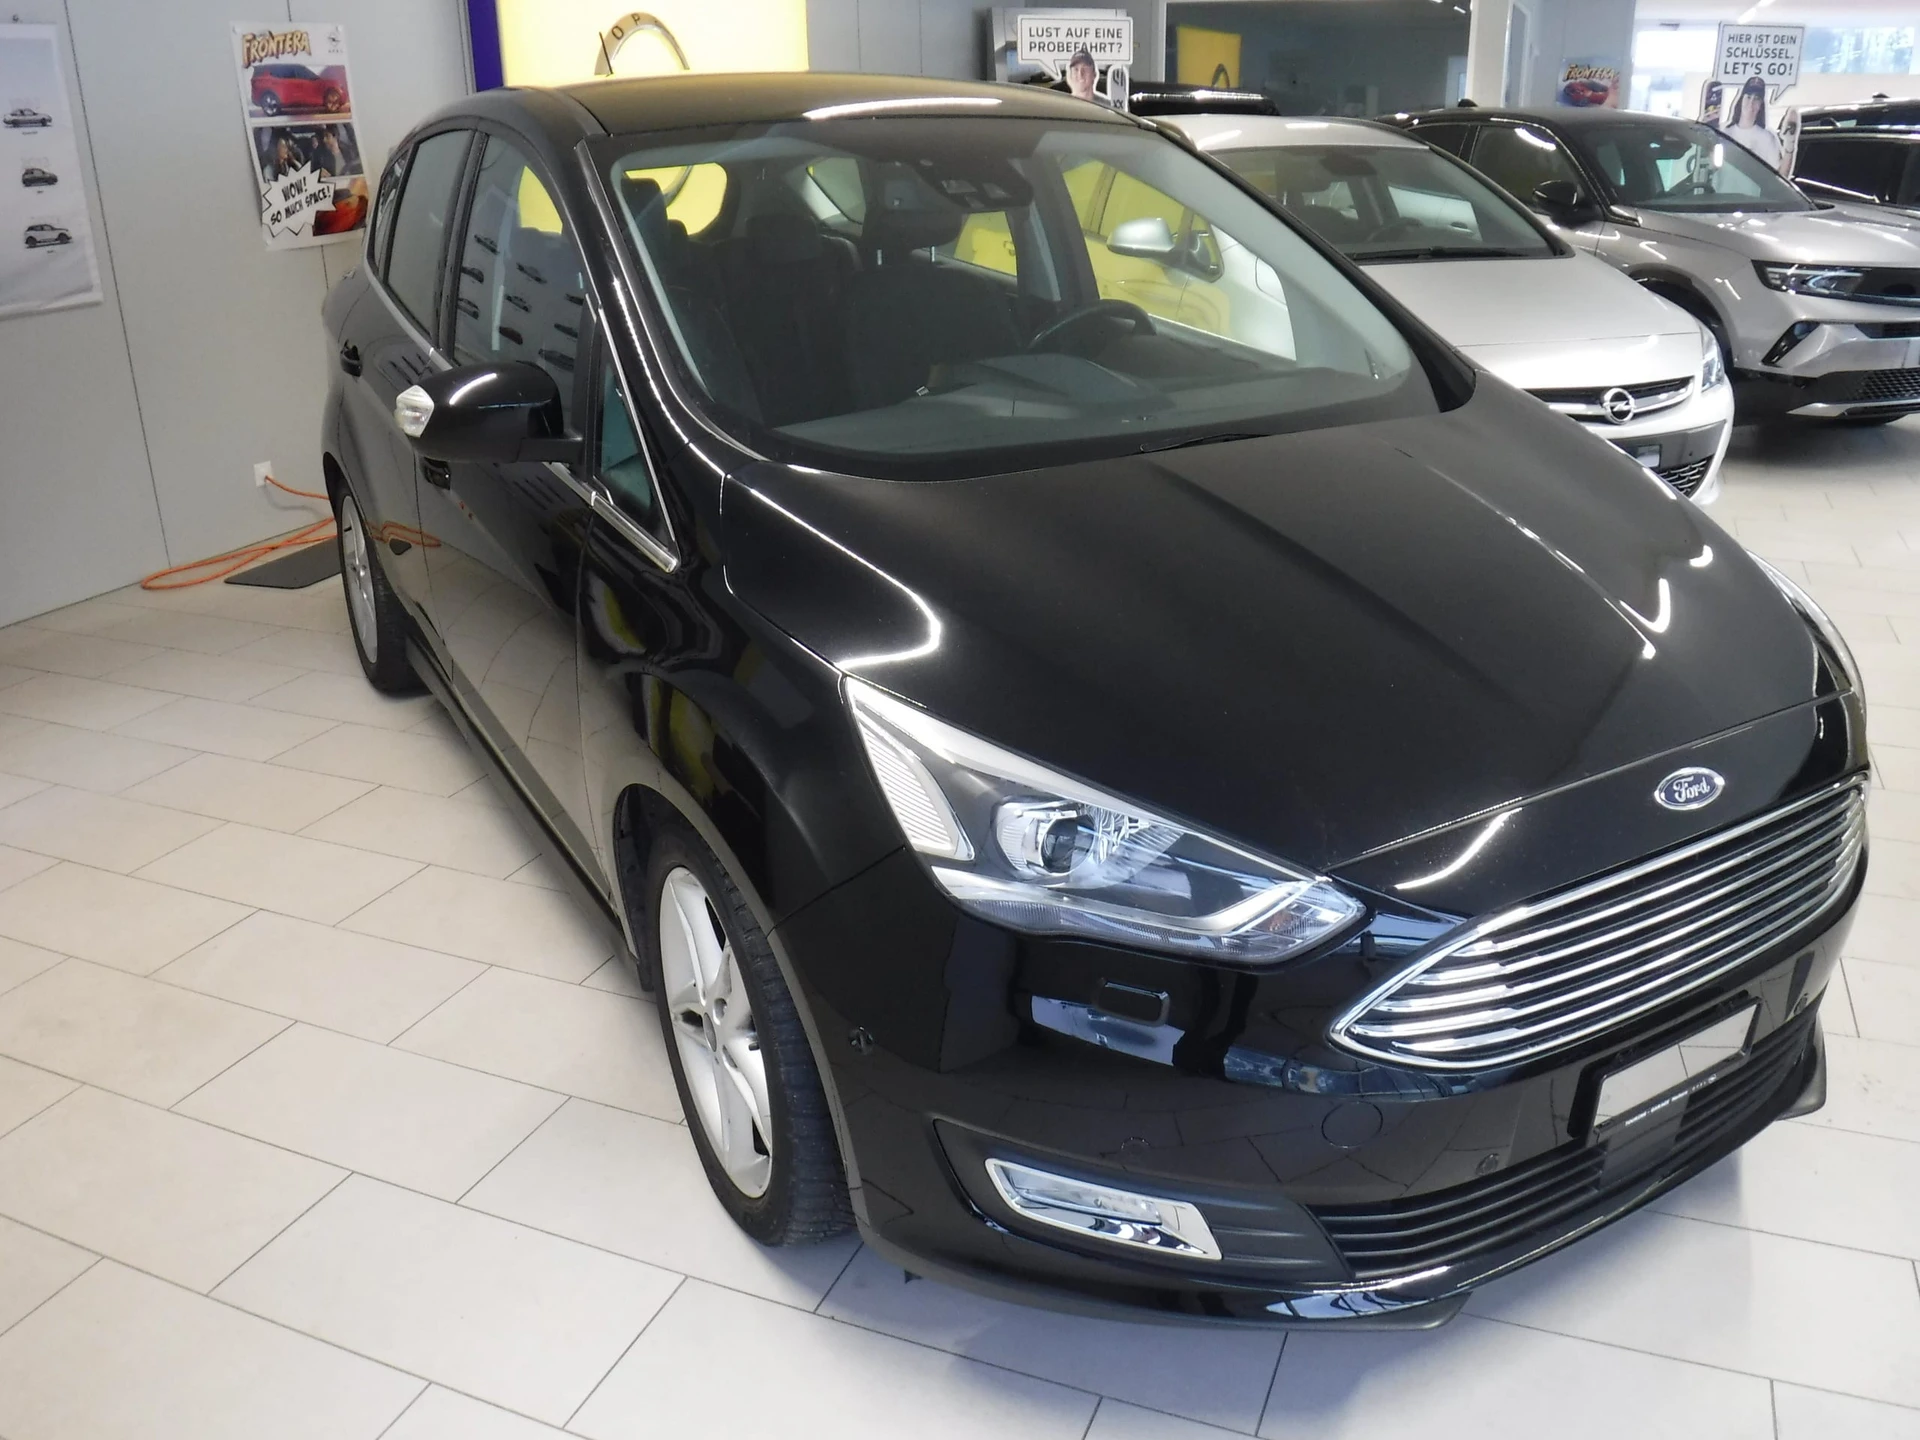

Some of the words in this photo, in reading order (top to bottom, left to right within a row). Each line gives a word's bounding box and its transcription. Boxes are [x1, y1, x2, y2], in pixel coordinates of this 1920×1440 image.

[1029, 27, 1061, 37] LUST
[1065, 27, 1090, 38] AUF
[1095, 28, 1122, 38] EINE
[1728, 33, 1752, 43] HIER
[1754, 34, 1770, 44] IST
[1773, 34, 1797, 44] DEIN
[242, 30, 312, 69] FRONTERA
[1029, 41, 1122, 53] PROBEFAHRT?
[1726, 44, 1794, 59] SCHLÜSSEL.
[1724, 62, 1762, 75] LET'S
[1767, 62, 1793, 76] GO!
[282, 176, 307, 201] WOW!
[270, 210, 282, 225] SO
[284, 199, 304, 219] MUCH
[305, 185, 331, 207] SPACE!
[1673, 775, 1710, 802] Ford
